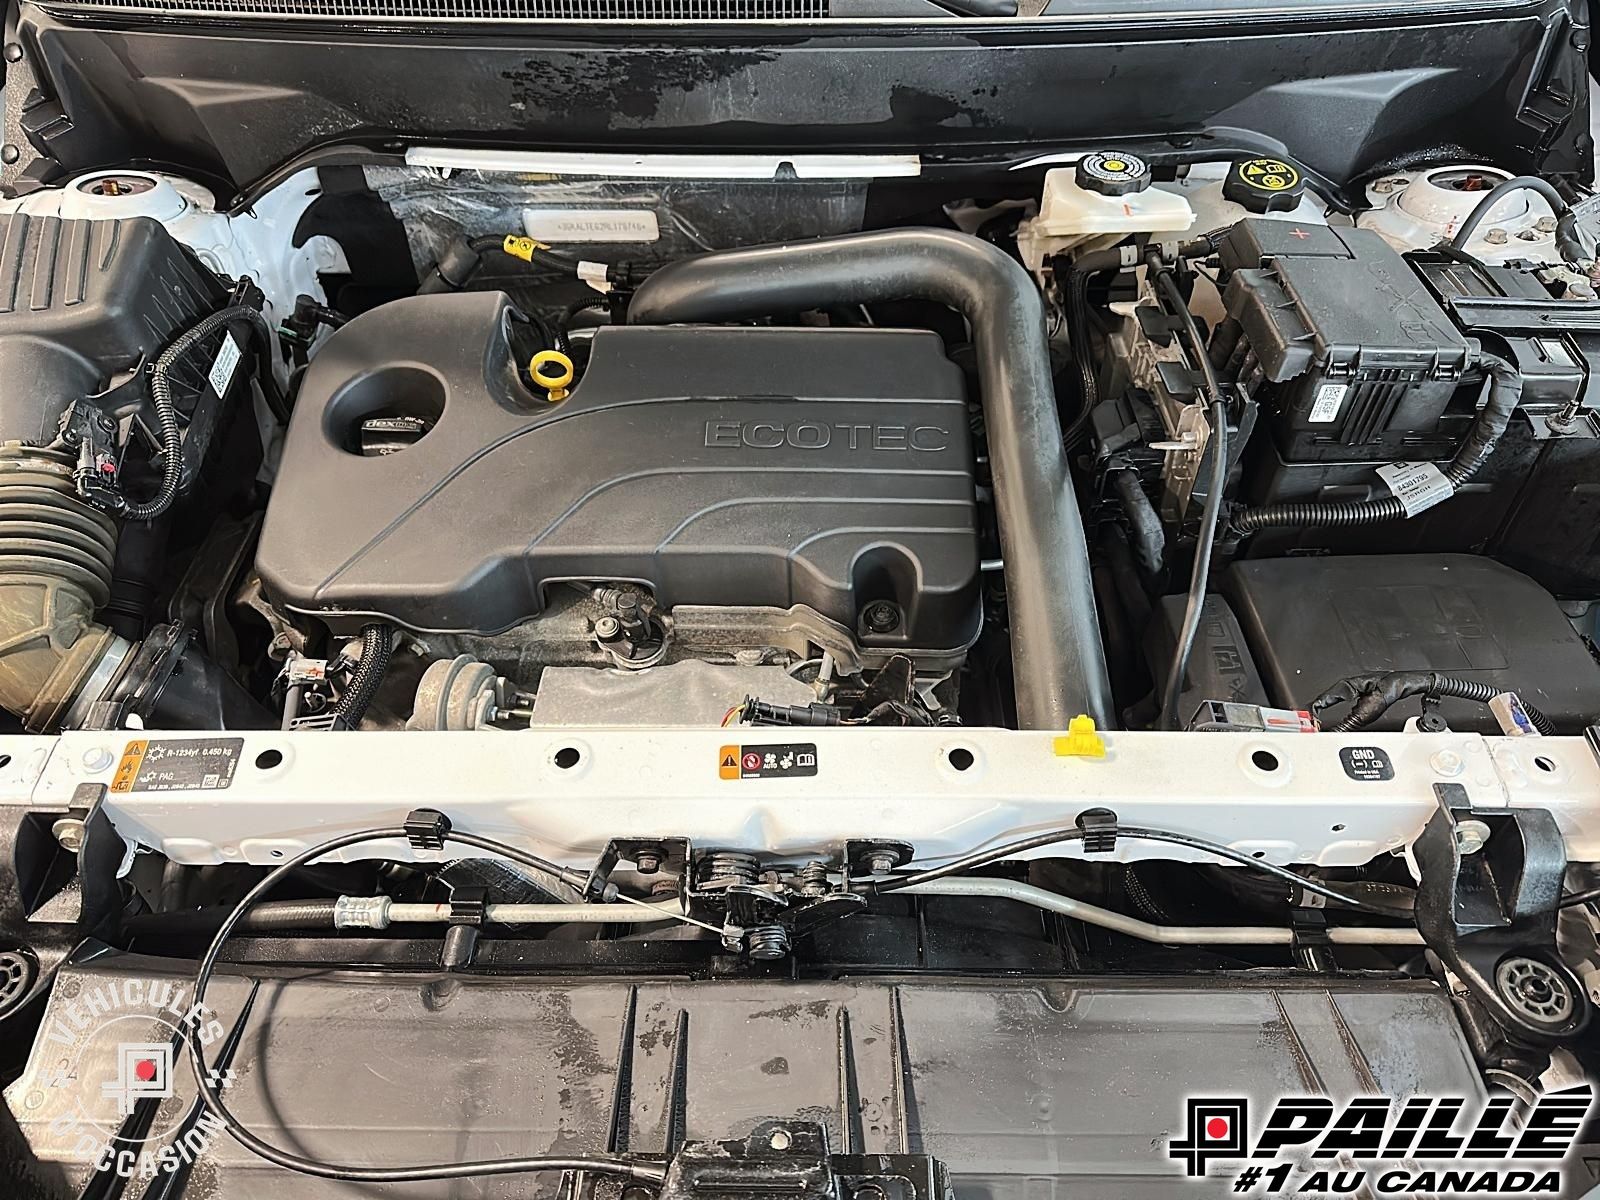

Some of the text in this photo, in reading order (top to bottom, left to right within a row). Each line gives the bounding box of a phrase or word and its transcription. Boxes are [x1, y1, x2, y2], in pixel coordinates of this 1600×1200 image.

[704, 420, 949, 451] ECOTEC
[166, 747, 232, 758] R-1234yf 0.450 kg
[1351, 749, 1375, 760] GND
[159, 772, 174, 781] PAG
